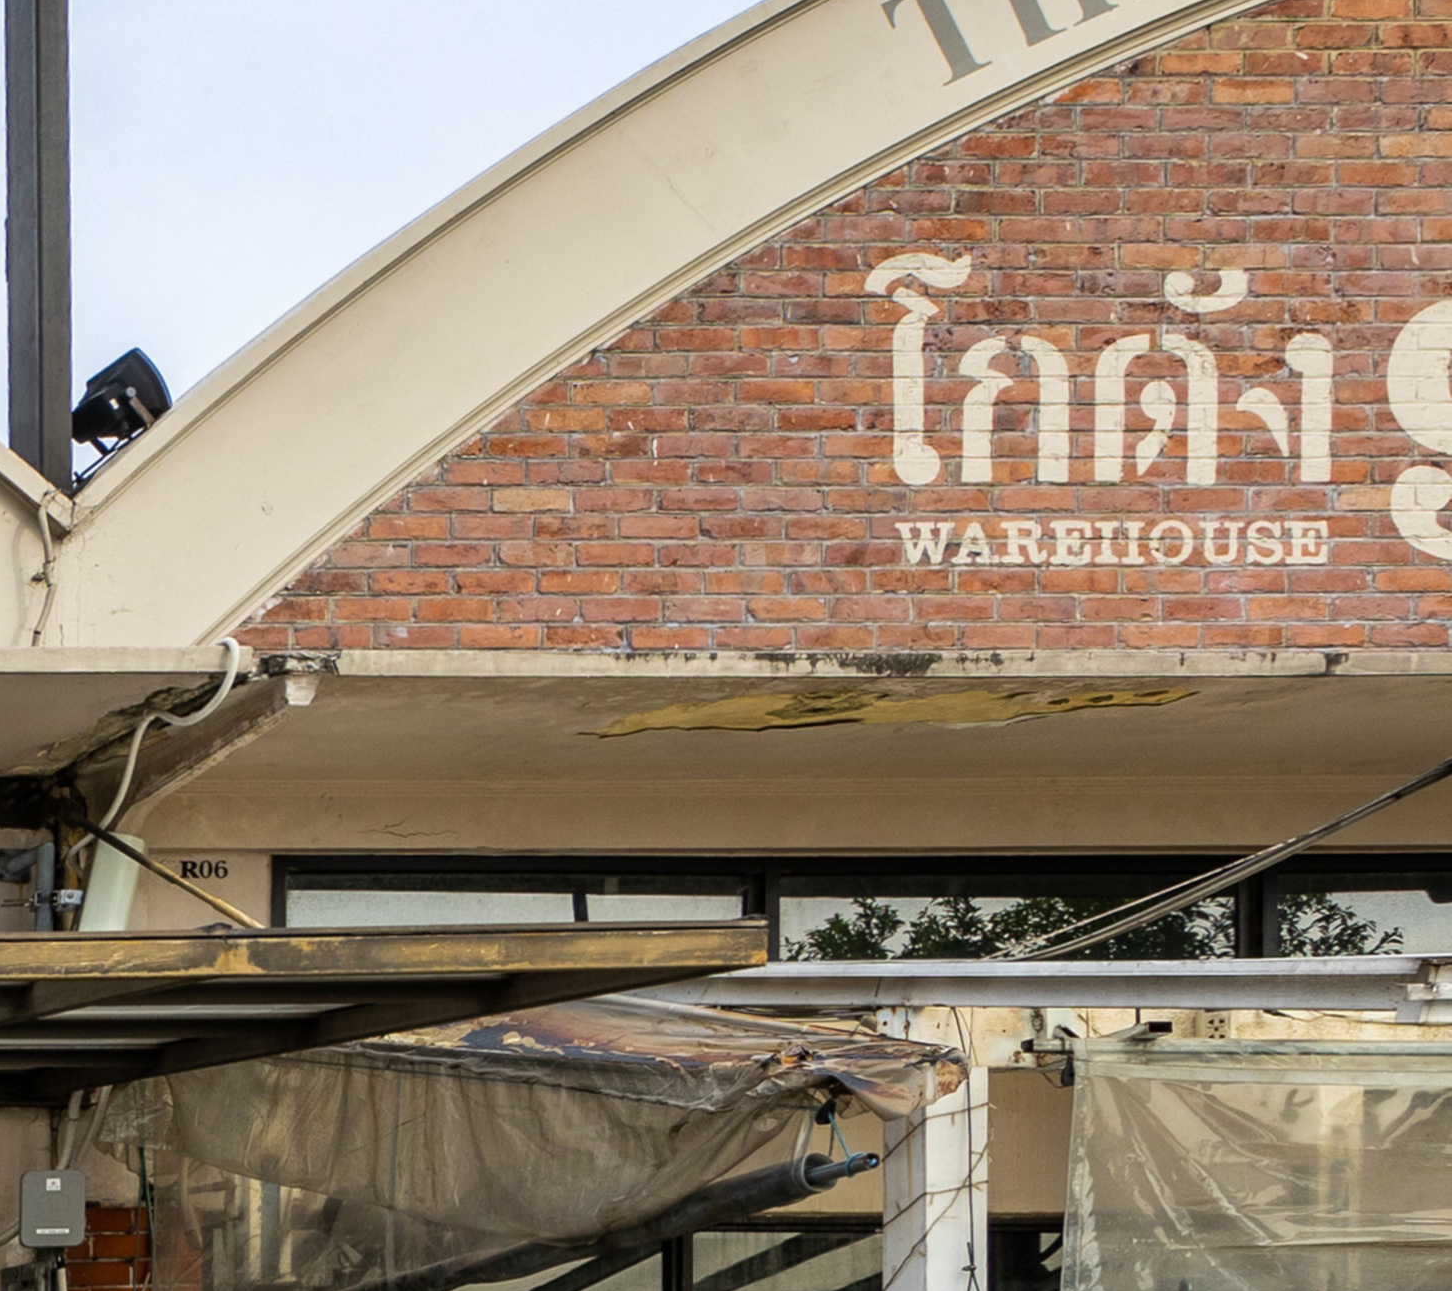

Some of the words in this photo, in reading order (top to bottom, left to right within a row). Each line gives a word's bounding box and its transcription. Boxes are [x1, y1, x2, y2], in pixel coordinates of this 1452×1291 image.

[864, 253, 1334, 486] โกดัง
[895, 519, 1330, 566] WAREHOUSE
[180, 860, 229, 879] R06
